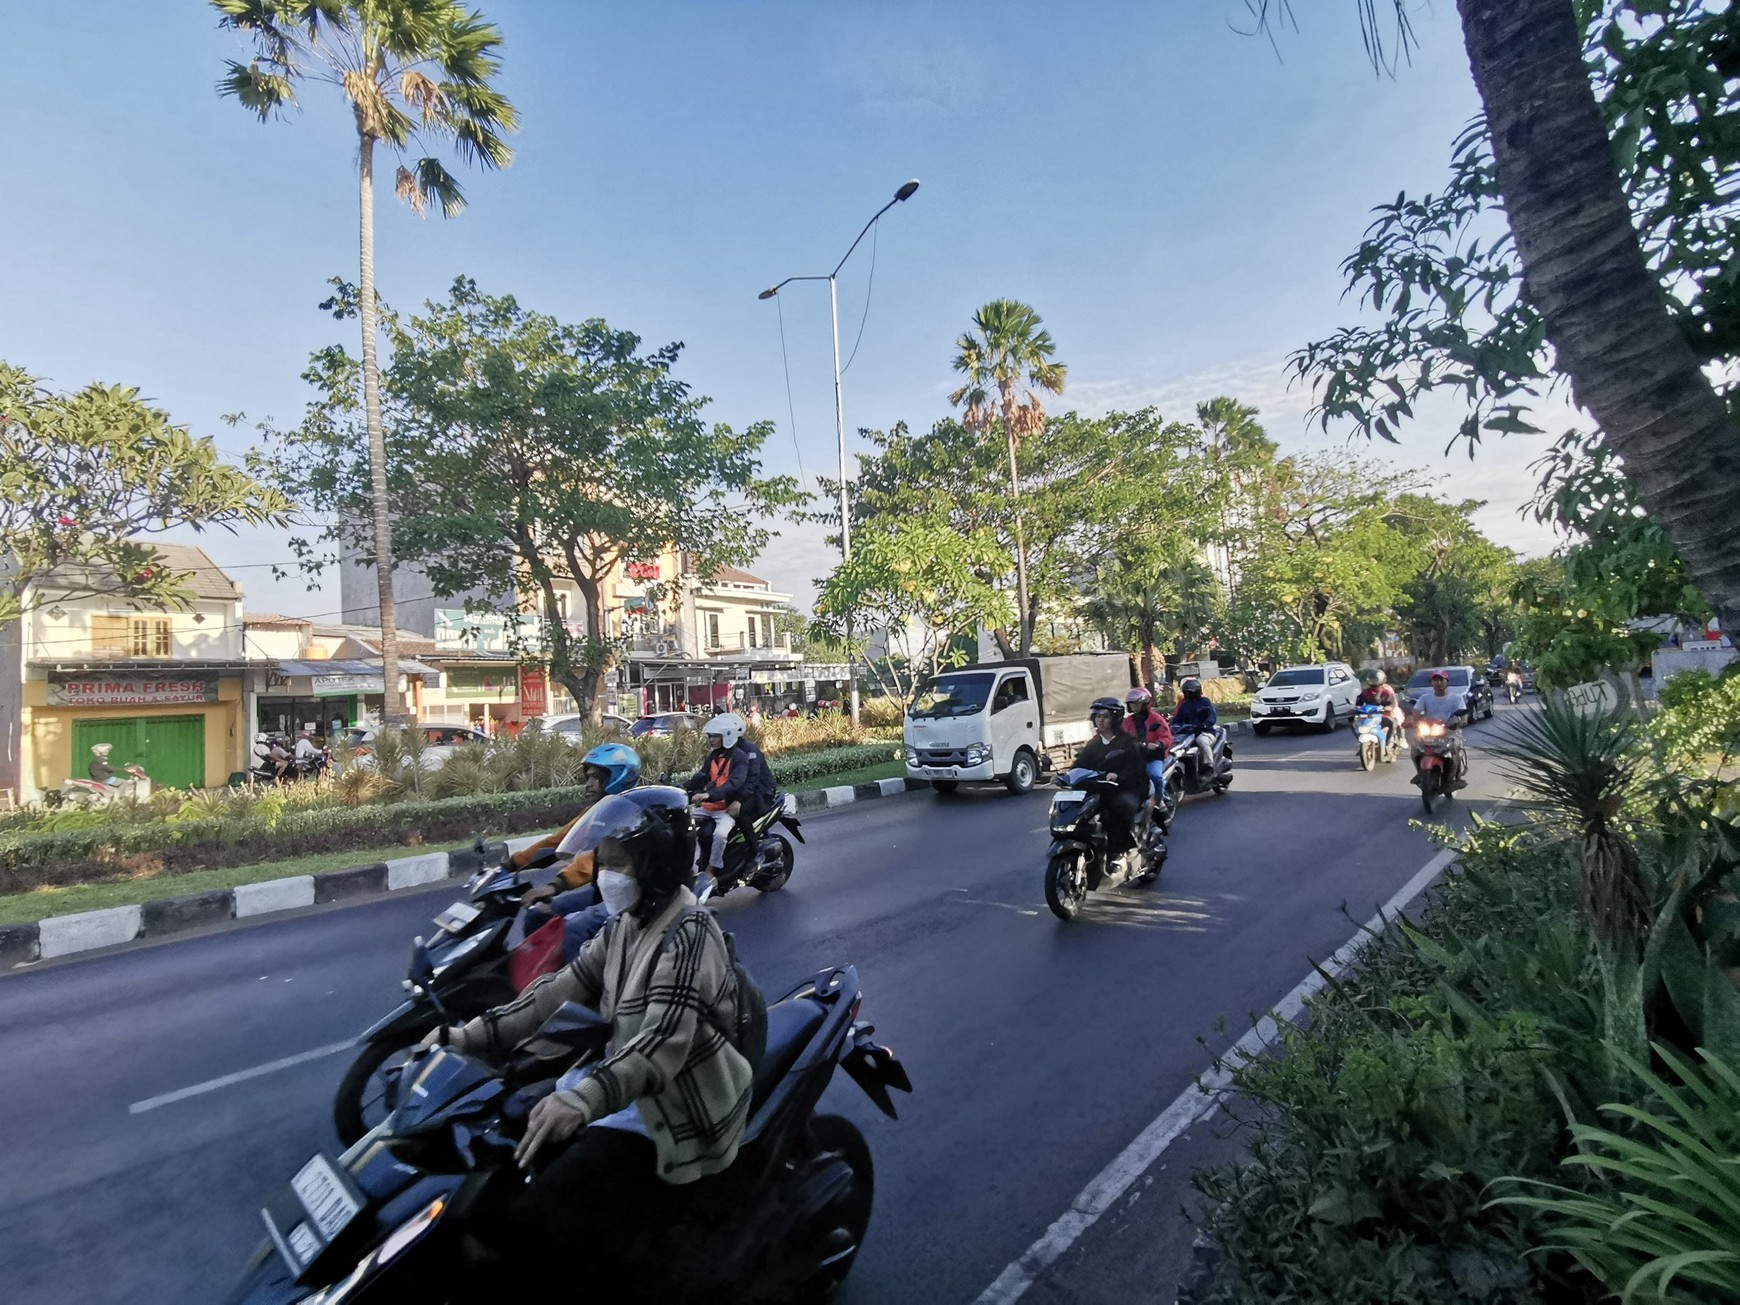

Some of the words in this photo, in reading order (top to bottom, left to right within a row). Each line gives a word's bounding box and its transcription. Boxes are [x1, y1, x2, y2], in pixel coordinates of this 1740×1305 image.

[67, 681, 136, 694] PRIMA
[142, 680, 205, 693] FRESH
[68, 697, 105, 706] TOKO
